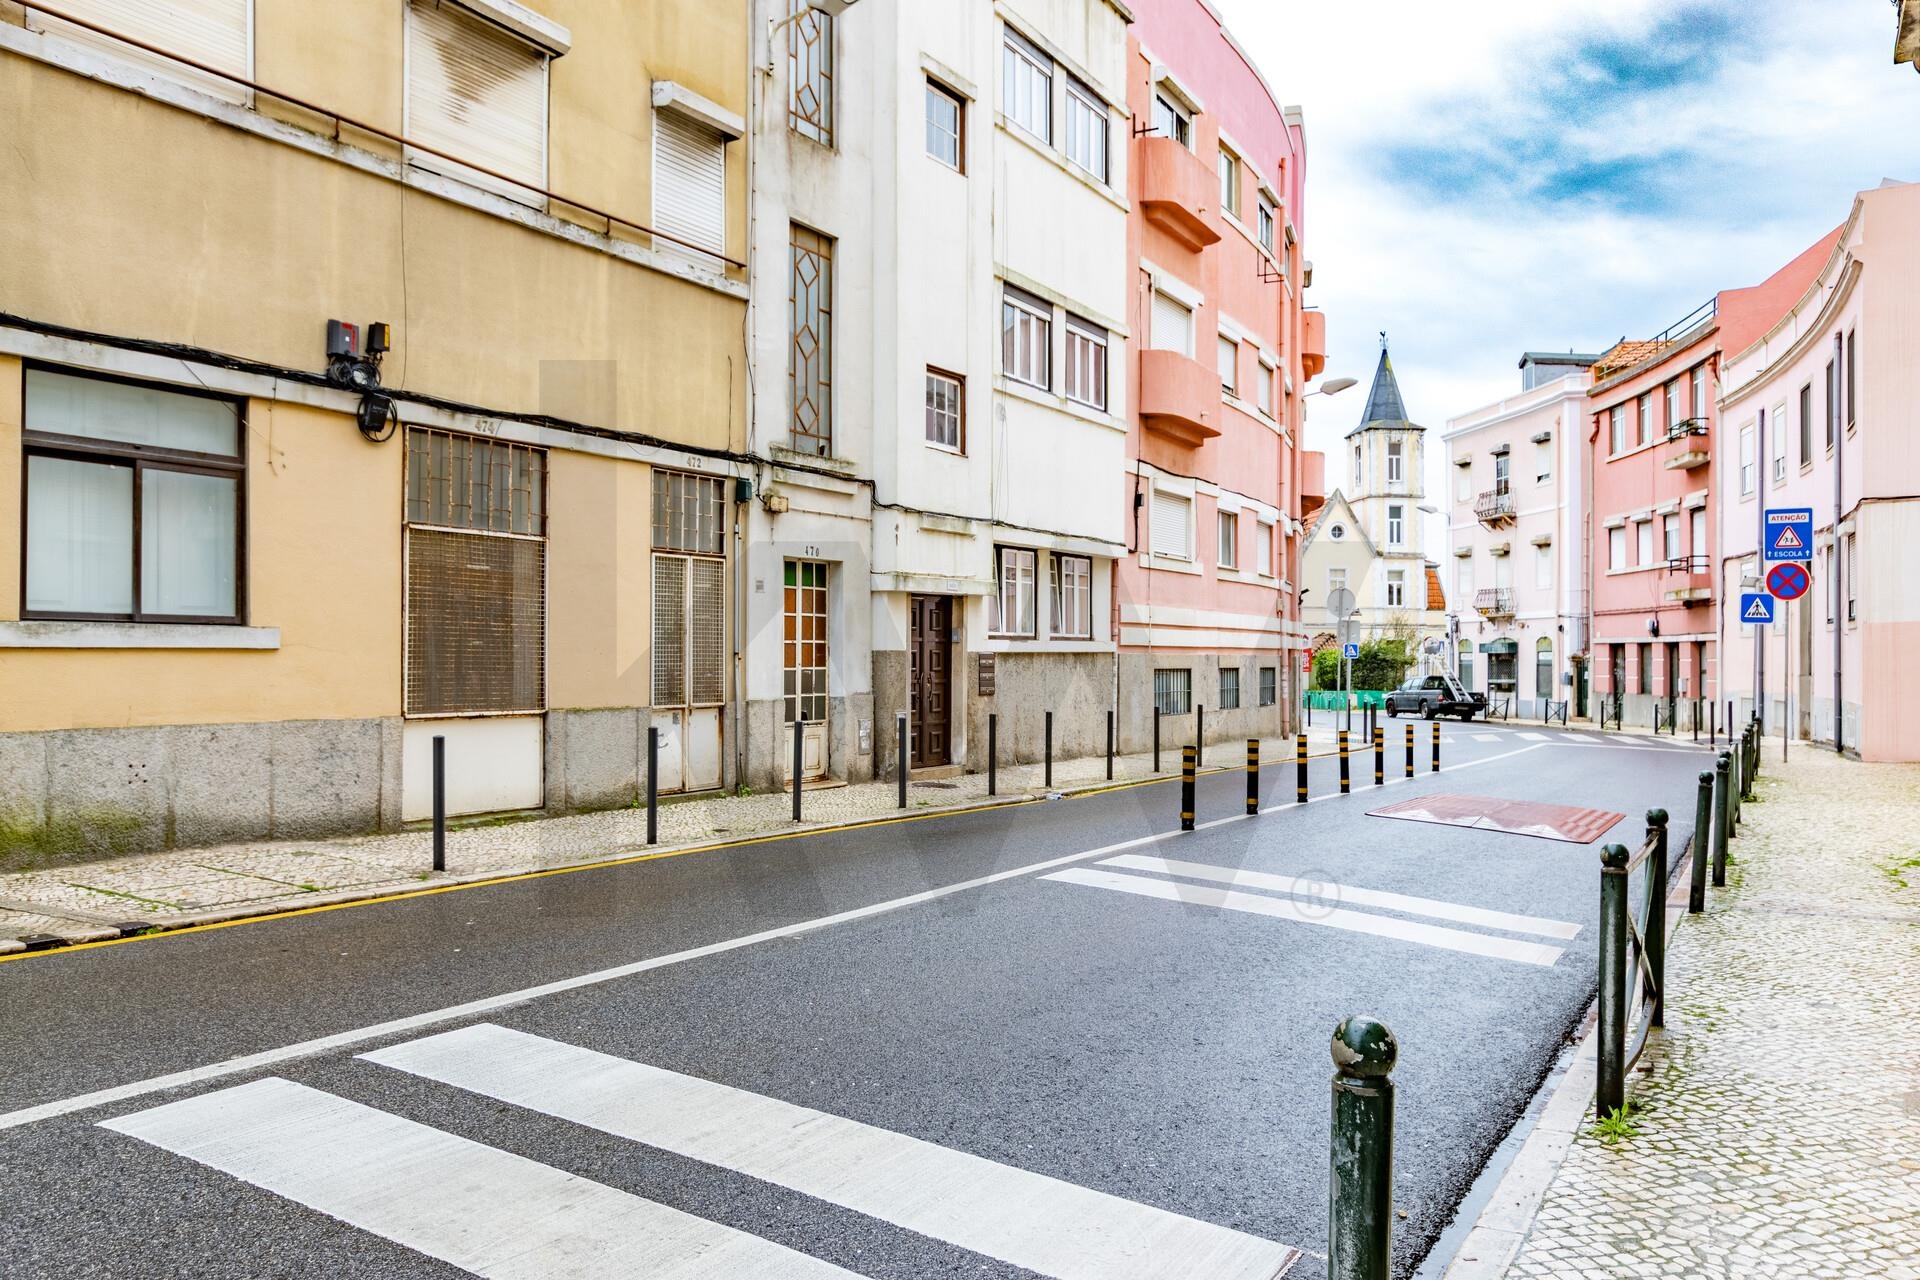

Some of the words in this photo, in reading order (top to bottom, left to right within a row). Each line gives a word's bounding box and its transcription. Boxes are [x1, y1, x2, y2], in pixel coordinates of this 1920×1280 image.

[475, 418, 496, 434] 474
[687, 455, 702, 468] 472
[804, 546, 820, 557] 470
